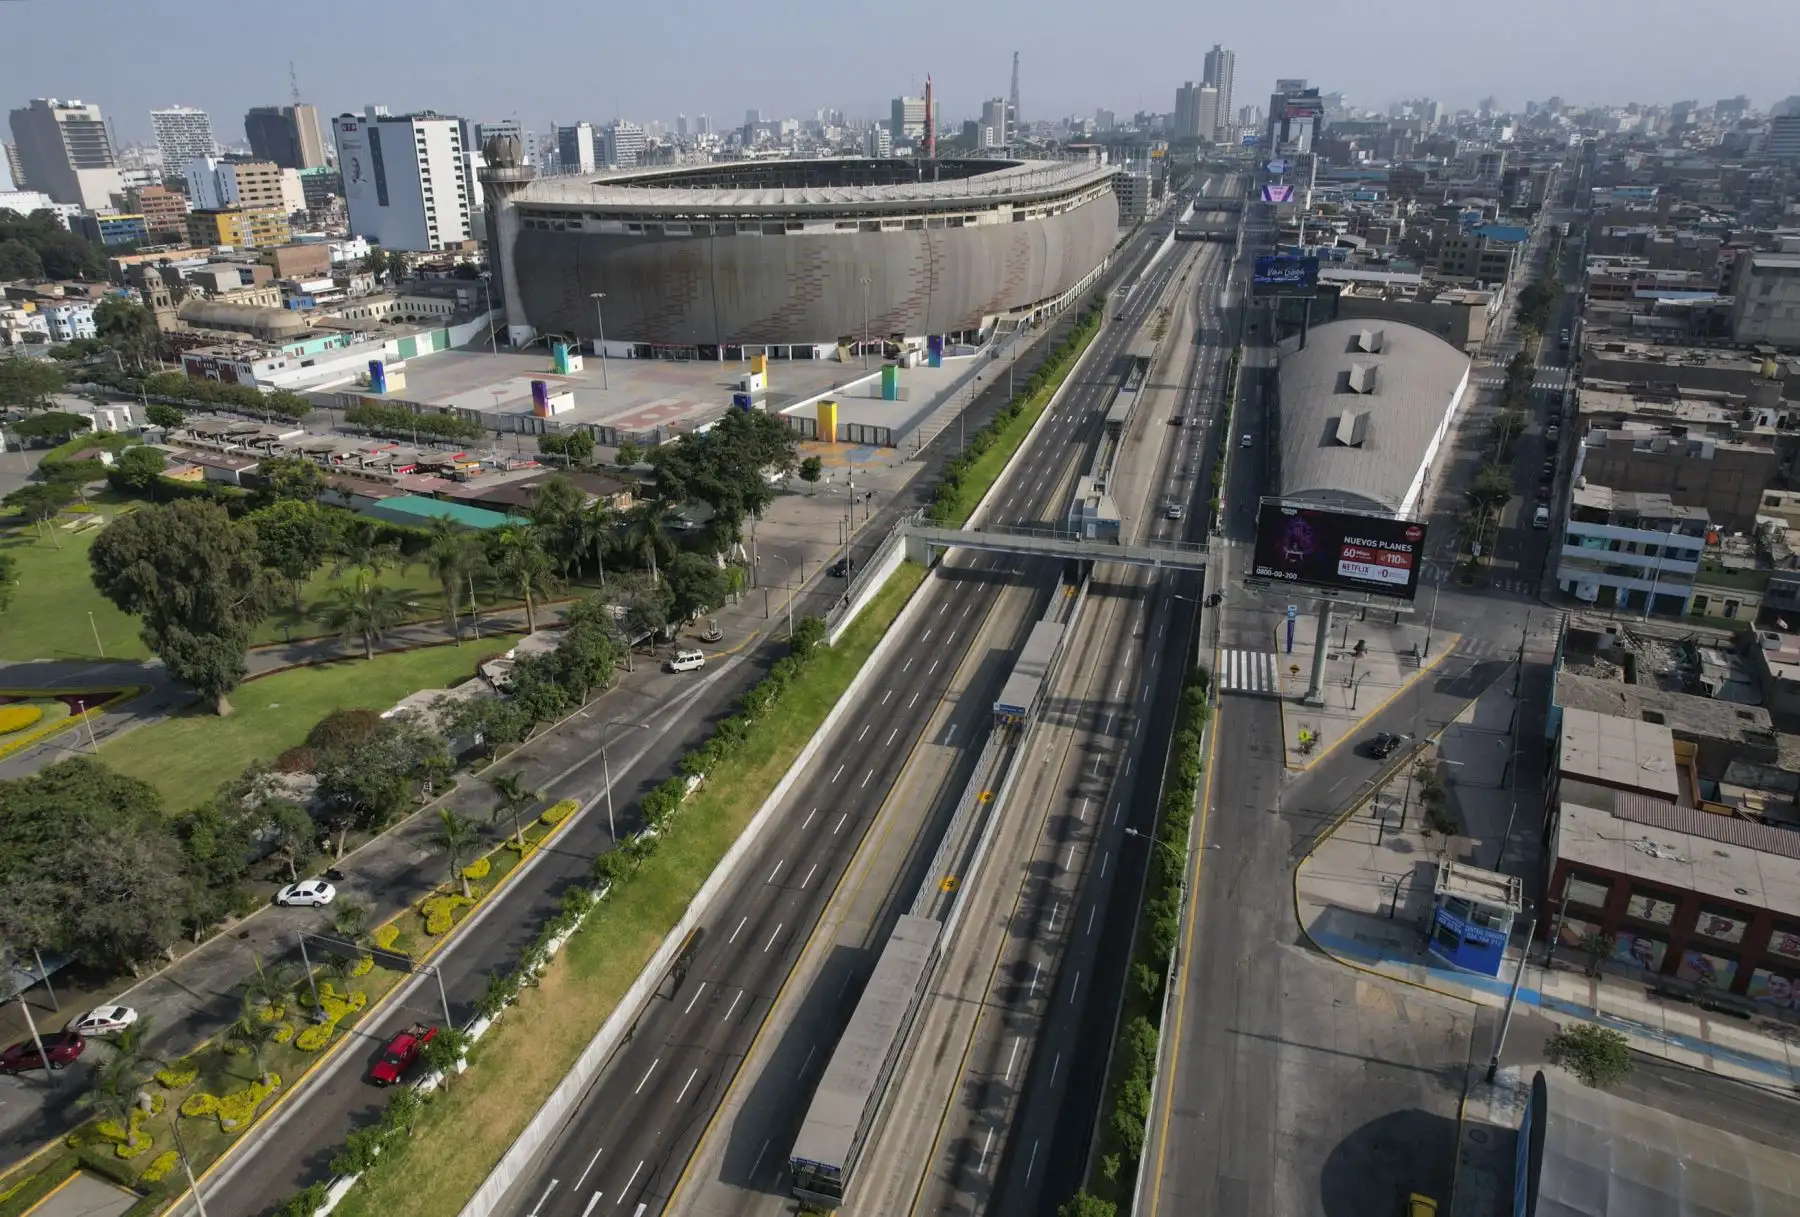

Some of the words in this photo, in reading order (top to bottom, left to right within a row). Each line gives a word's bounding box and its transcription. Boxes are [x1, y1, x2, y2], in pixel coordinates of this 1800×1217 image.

[1267, 267, 1283, 277] Van
[1285, 267, 1305, 279] Gogh
[1343, 536, 1378, 548] NUEVOS
[1379, 540, 1413, 552] PLANES
[1343, 547, 1356, 558] 60
[1386, 553, 1401, 564] 110
[1256, 567, 1298, 580] 0800-00-200
[1342, 562, 1369, 574] NETFLIX
